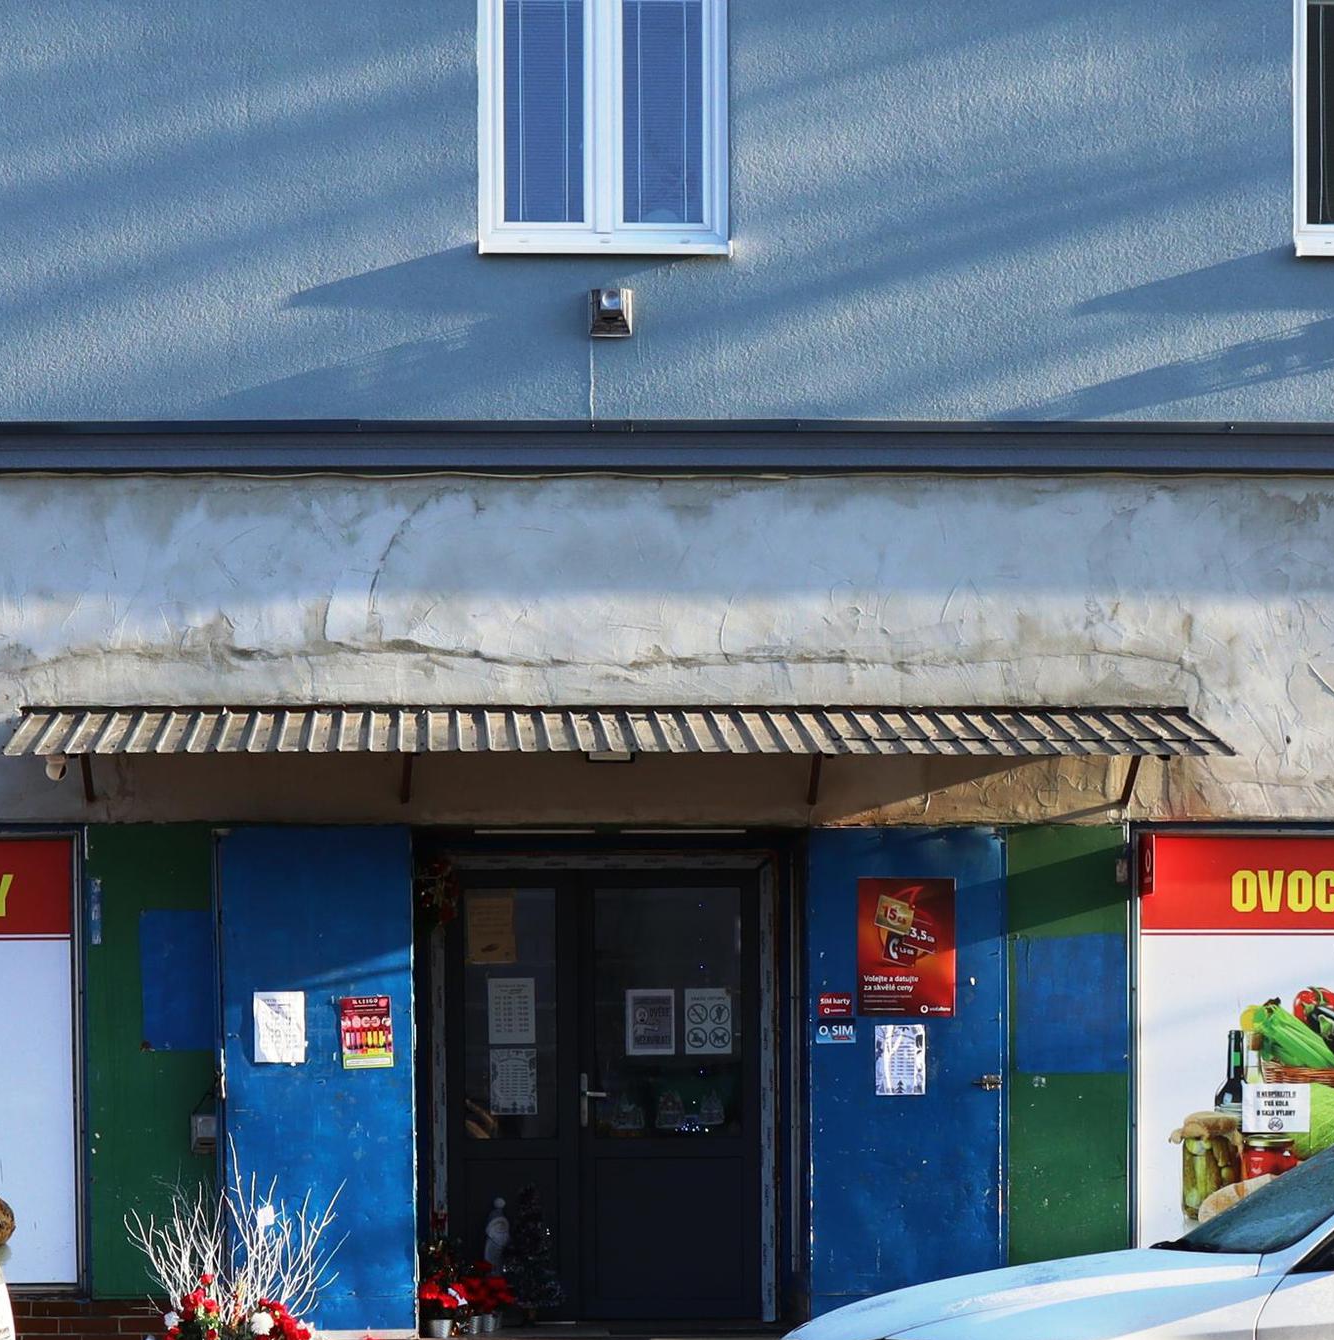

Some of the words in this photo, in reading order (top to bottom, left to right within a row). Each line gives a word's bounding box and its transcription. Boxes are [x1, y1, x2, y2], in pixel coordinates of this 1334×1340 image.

[863, 975, 888, 983] Volejte
[894, 975, 919, 983] datujte
[897, 985, 914, 993] ceny
[832, 1025, 854, 1036] SIM
